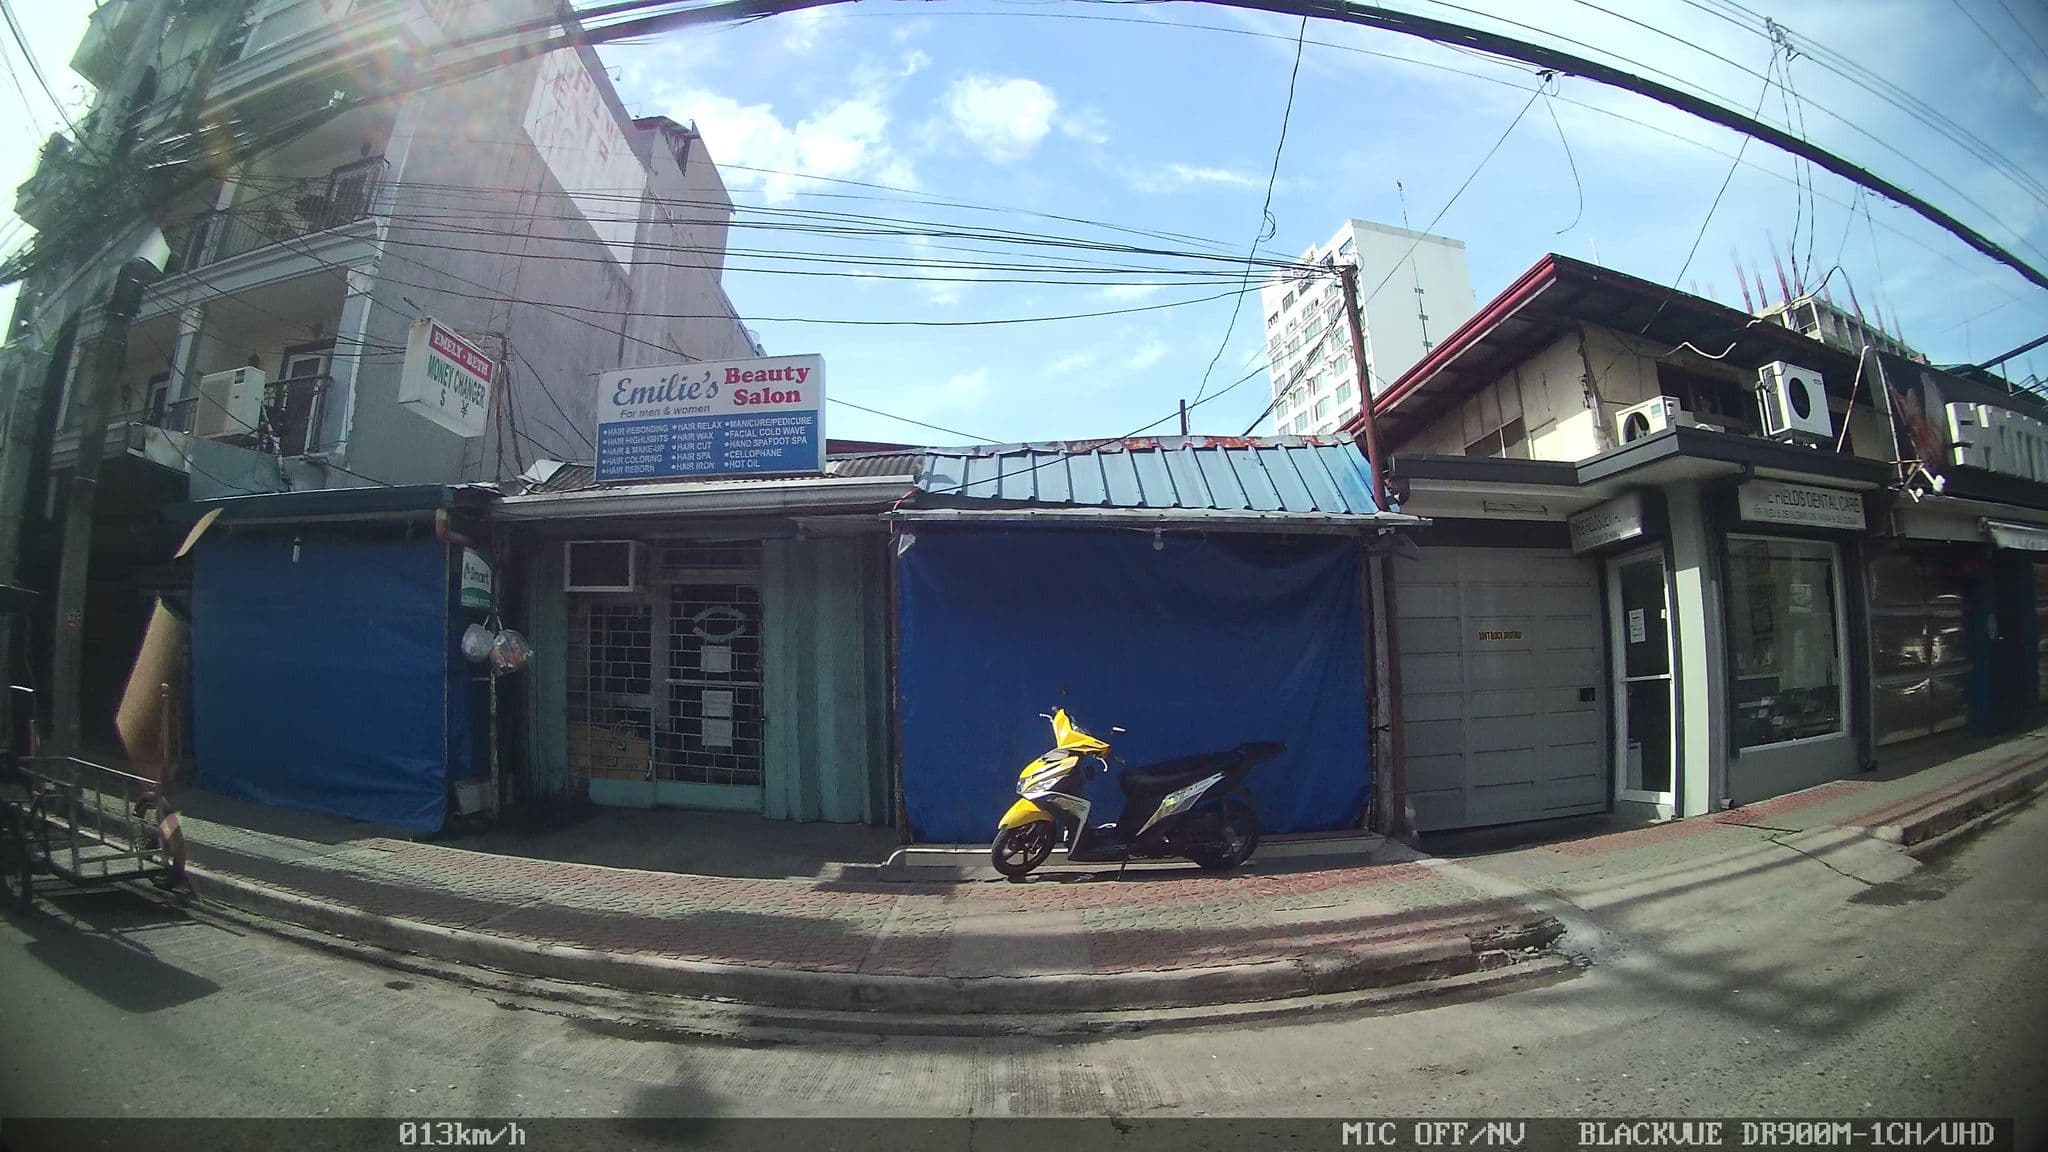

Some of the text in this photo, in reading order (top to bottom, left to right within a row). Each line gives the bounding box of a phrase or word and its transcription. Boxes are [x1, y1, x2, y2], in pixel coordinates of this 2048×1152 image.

[467, 353, 489, 376] BETH
[427, 354, 486, 408] MONEY CHANGER
[724, 366, 811, 385] Beauty
[612, 370, 719, 407] Emilie's
[733, 387, 801, 406] Salon
[620, 404, 710, 419] For men & women
[607, 424, 669, 436] HAIR REBONDING
[677, 421, 722, 431] HAIR RELAX
[729, 426, 806, 438] FACIAL COLD WAVE
[607, 434, 669, 446] HAIR HIGHLIGHTS
[677, 431, 714, 441] HAIR WAX
[729, 440, 751, 448] HAND
[791, 436, 807, 445] SPA
[607, 447, 624, 455] HAIR
[632, 444, 665, 454] MAKE-UP
[677, 441, 712, 451] HAIR CUT
[607, 454, 662, 465] HAIR COLORING
[676, 451, 711, 461] HAIR SPA
[729, 449, 782, 459] CELLOPHANE
[606, 464, 655, 475] HAIR REBORN
[676, 461, 715, 471] HAIR IRON
[729, 459, 760, 468] HOT OIL
[1806, 491, 1839, 511] DENTAL
[1840, 495, 1860, 513] CARE
